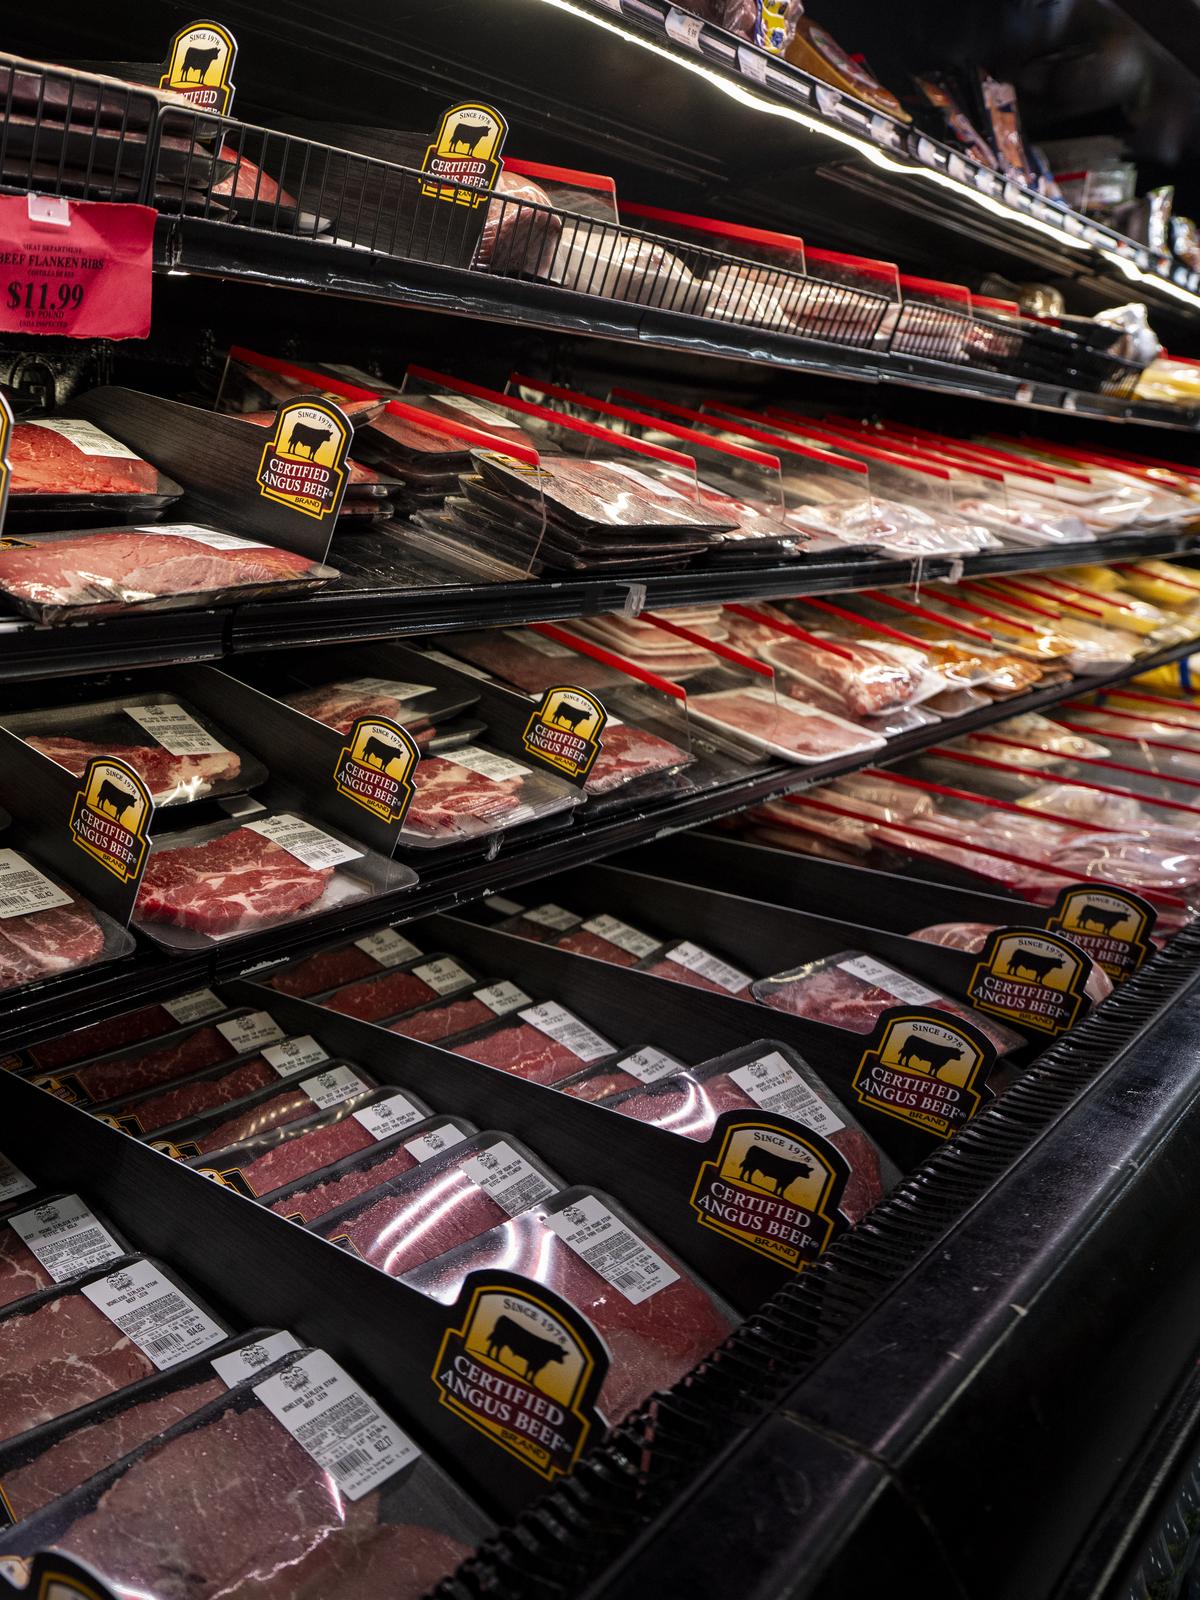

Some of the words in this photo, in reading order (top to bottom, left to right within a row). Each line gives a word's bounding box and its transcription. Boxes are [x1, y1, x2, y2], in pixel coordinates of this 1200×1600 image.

[183, 90, 218, 105] TIFIED
[430, 159, 486, 175] CERTIFIED
[29, 255, 79, 268] FLANKEN
[81, 257, 104, 270] RIBS
[7, 281, 84, 311] $11.99
[38, 310, 65, 319] POUND
[297, 410, 316, 420] SINCE
[318, 415, 333, 429] 1978
[261, 470, 301, 493] ANGUS
[269, 458, 330, 483] CERTIFIED
[295, 496, 321, 508] BRAND
[562, 693, 580, 703] SINCE
[372, 726, 390, 738] SINCE
[390, 734, 403, 748] 1978
[527, 732, 561, 753] ANGUS
[534, 723, 586, 751] CERTIFIED
[554, 755, 576, 768] BRAND
[105, 767, 122, 785] SINCE
[337, 770, 373, 798] ANGUS
[345, 761, 399, 793] CERTIFIED
[367, 797, 390, 813] BRAND
[73, 819, 109, 852] ANGUS
[79, 807, 134, 848] CERTIFIED
[102, 852, 125, 870] BRAND
[1018, 939, 1043, 948] SINCE
[1045, 945, 1064, 958] 1978
[1055, 929, 1130, 954] CERTIFIED
[973, 986, 1025, 1009] ANGUS
[983, 976, 1064, 1005] CERTIFIED
[1019, 1012, 1052, 1025] BRAND
[911, 1023, 942, 1037] SINCE
[942, 1033, 963, 1049] 1978
[859, 1077, 918, 1108] ANGUS
[871, 1066, 961, 1103] CERTIFIED
[908, 1110, 946, 1128] BRAND
[753, 1131, 786, 1148] SINCE
[786, 1143, 812, 1164] 1978
[697, 1194, 763, 1232] ANGUS
[709, 1181, 811, 1229] CERTIFIED
[753, 1235, 797, 1259] BRAND
[106, 1294, 128, 1307] BONELESS
[127, 1286, 146, 1297] SIRLOIN
[125, 1296, 136, 1304] BEEF
[137, 1291, 149, 1299] LOIN
[503, 1298, 537, 1322] SINCE
[539, 1316, 568, 1345] 1978
[439, 1370, 511, 1422] ANGUS
[453, 1354, 564, 1429] CERTIFIED
[501, 1428, 547, 1461] BRAND
